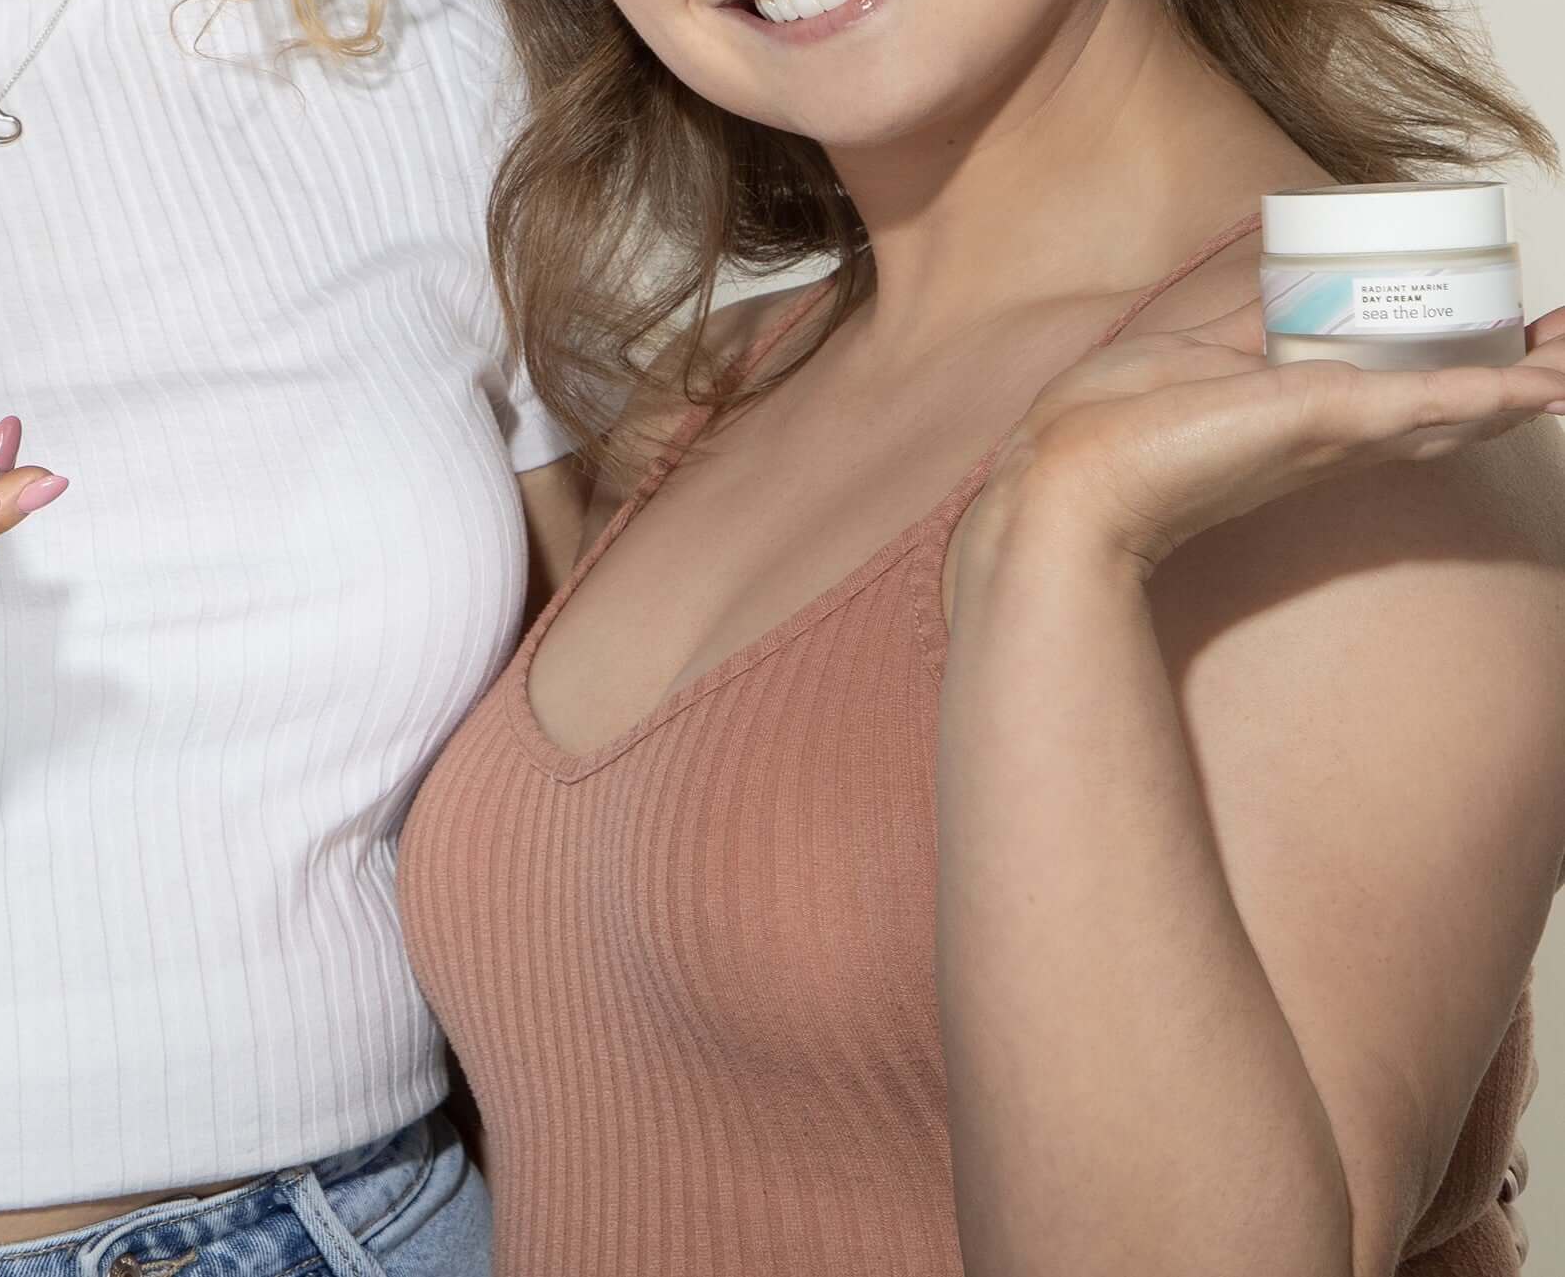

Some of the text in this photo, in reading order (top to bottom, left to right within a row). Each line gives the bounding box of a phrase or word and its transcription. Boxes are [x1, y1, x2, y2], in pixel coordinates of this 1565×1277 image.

[1361, 283, 1450, 293] RADIANT MARINE
[1386, 295, 1423, 303] CREAM
[1362, 304, 1453, 320] sea the love
